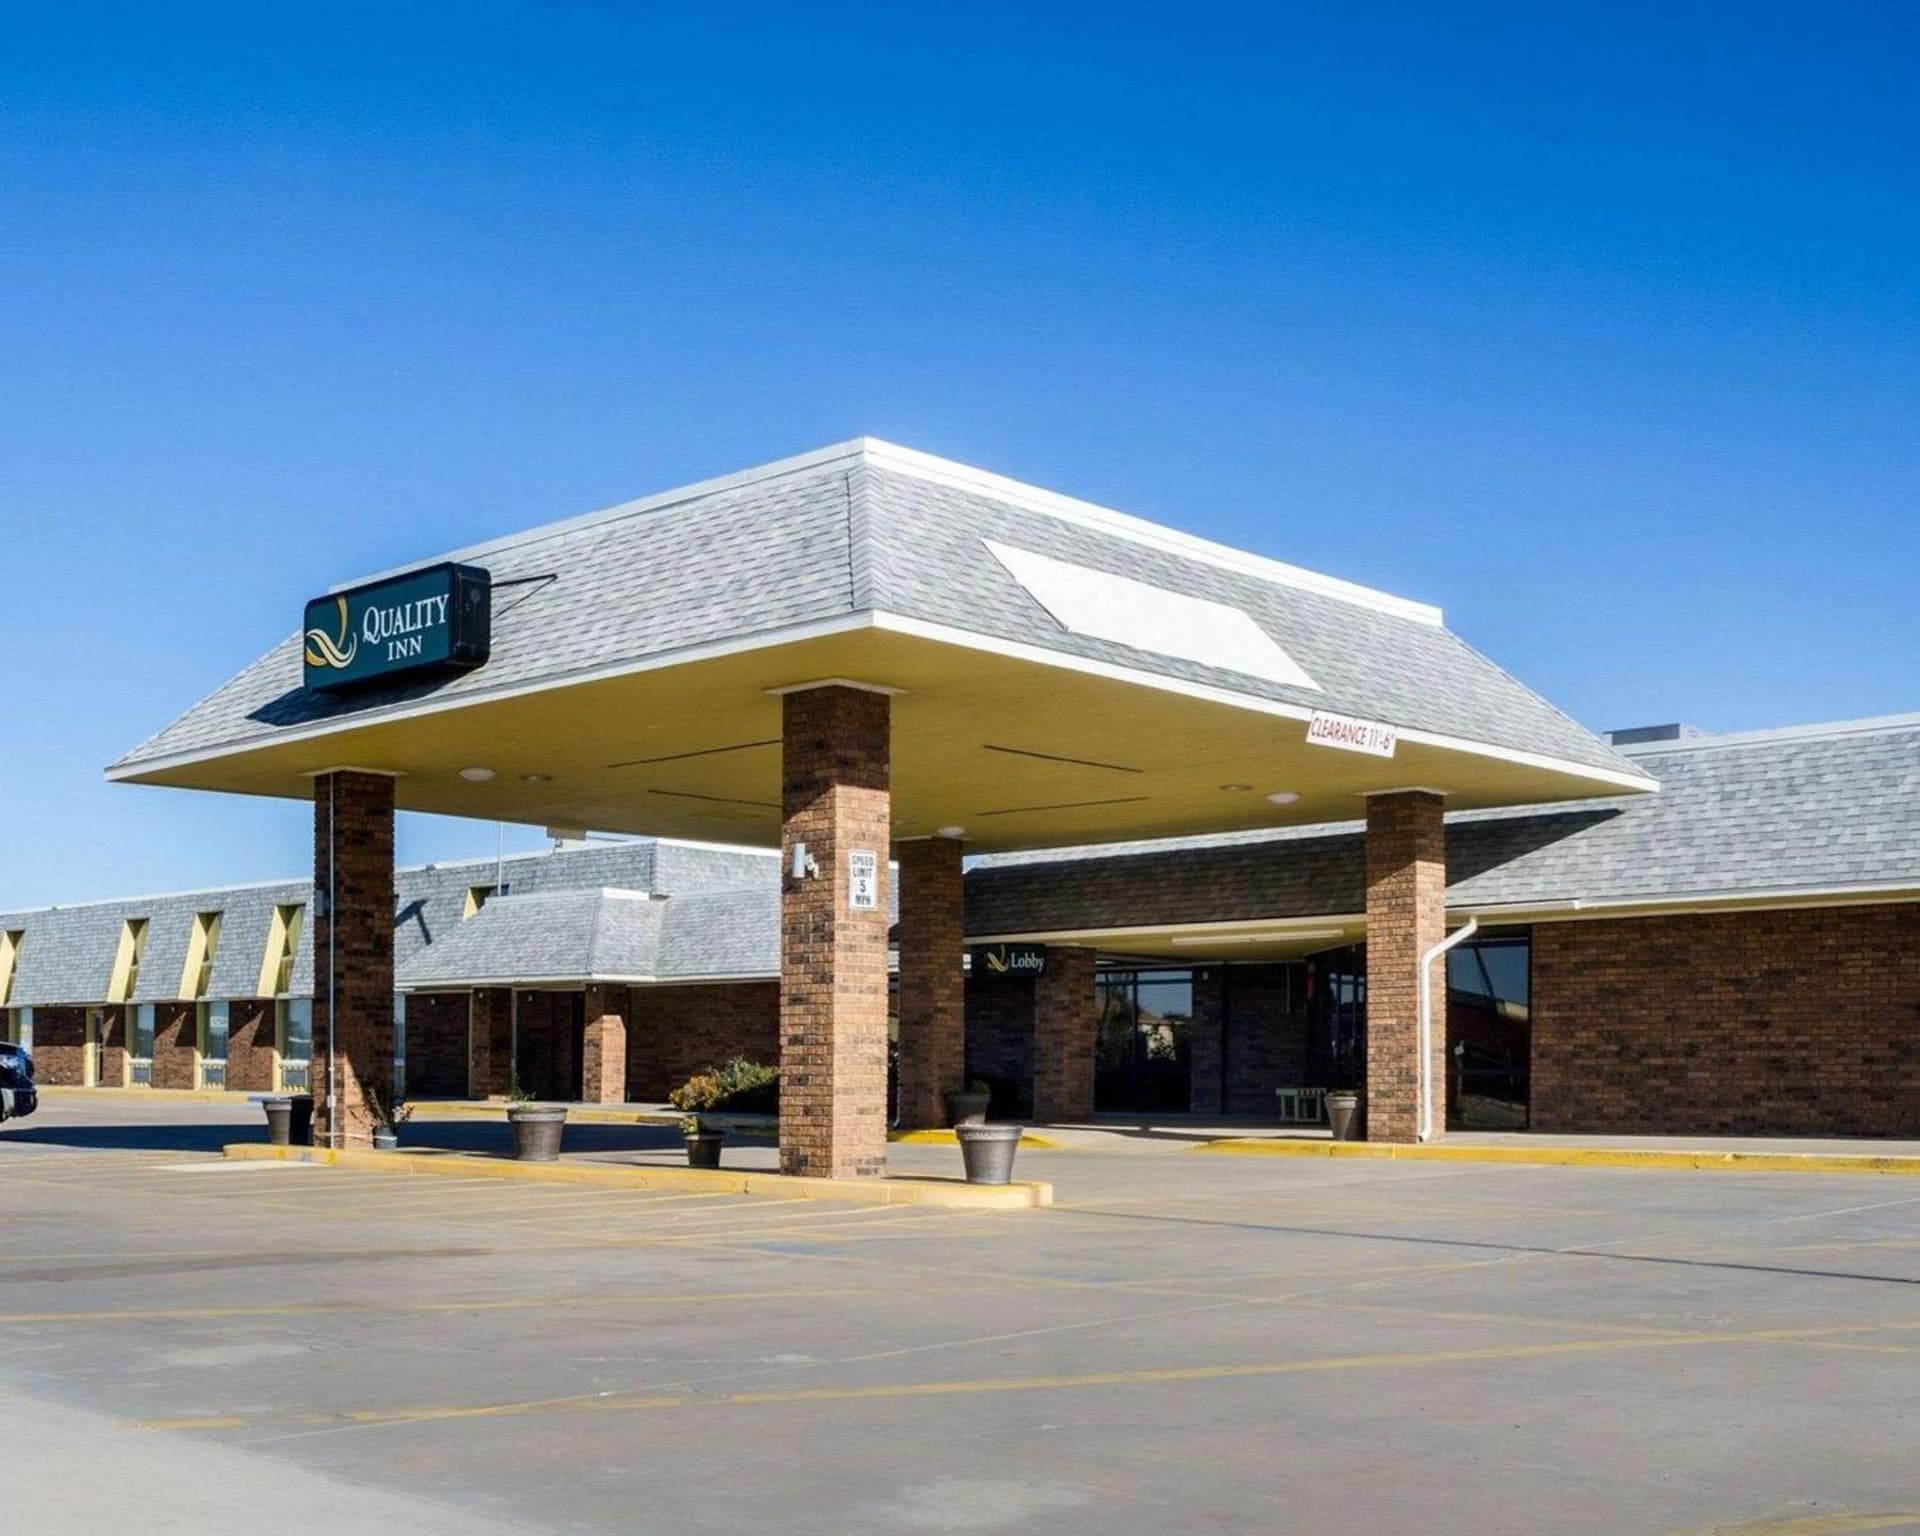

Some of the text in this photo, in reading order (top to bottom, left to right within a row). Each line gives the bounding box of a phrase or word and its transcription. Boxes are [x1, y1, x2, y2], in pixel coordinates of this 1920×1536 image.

[362, 593, 449, 644] QUALITY
[387, 635, 423, 662] INN
[1311, 718, 1367, 745] CLEARANCE
[852, 855, 874, 866] SPEED
[853, 867, 872, 878] LIMIT
[859, 879, 866, 893] 5
[855, 894, 871, 905] MPH
[1011, 952, 1044, 972] Lobby
